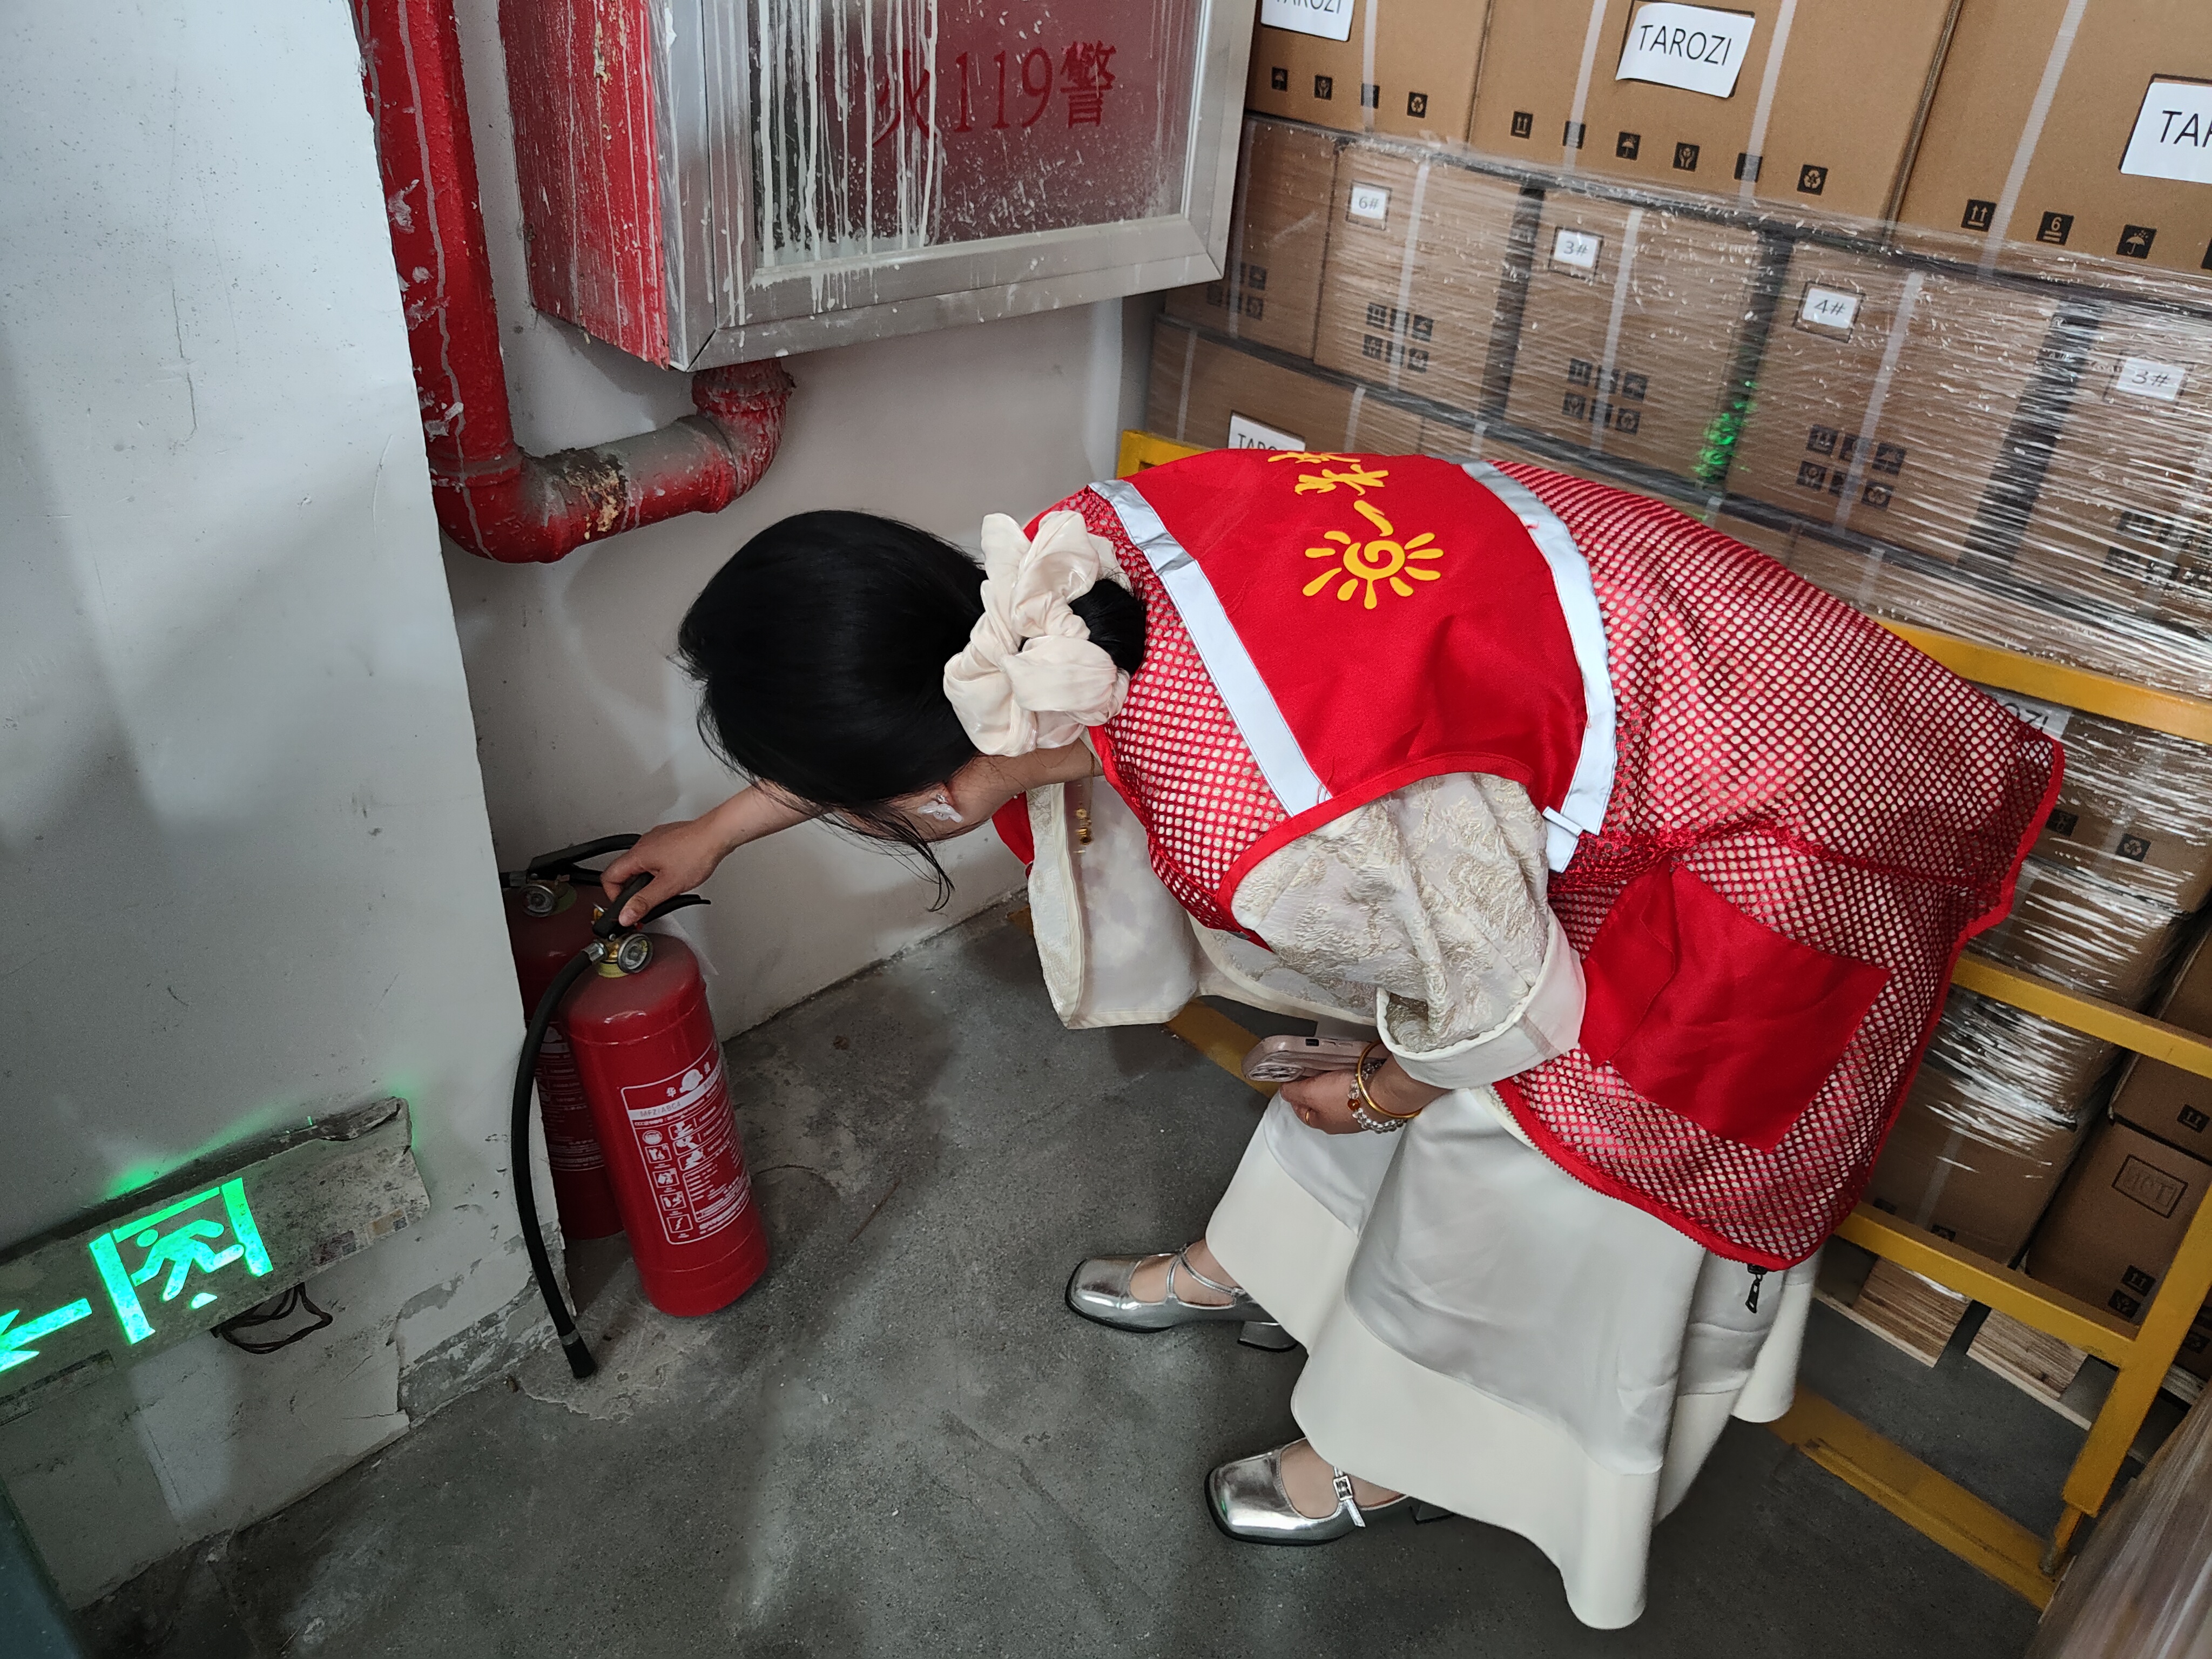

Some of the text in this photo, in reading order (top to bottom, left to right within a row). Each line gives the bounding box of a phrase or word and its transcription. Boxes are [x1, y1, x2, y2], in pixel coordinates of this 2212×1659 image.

[1640, 25, 1732, 66] TAROZI
[1359, 196, 1379, 210] 6#
[1563, 241, 1588, 257] 3#
[1814, 300, 1845, 315] 4#
[2132, 370, 2170, 387] 3#
